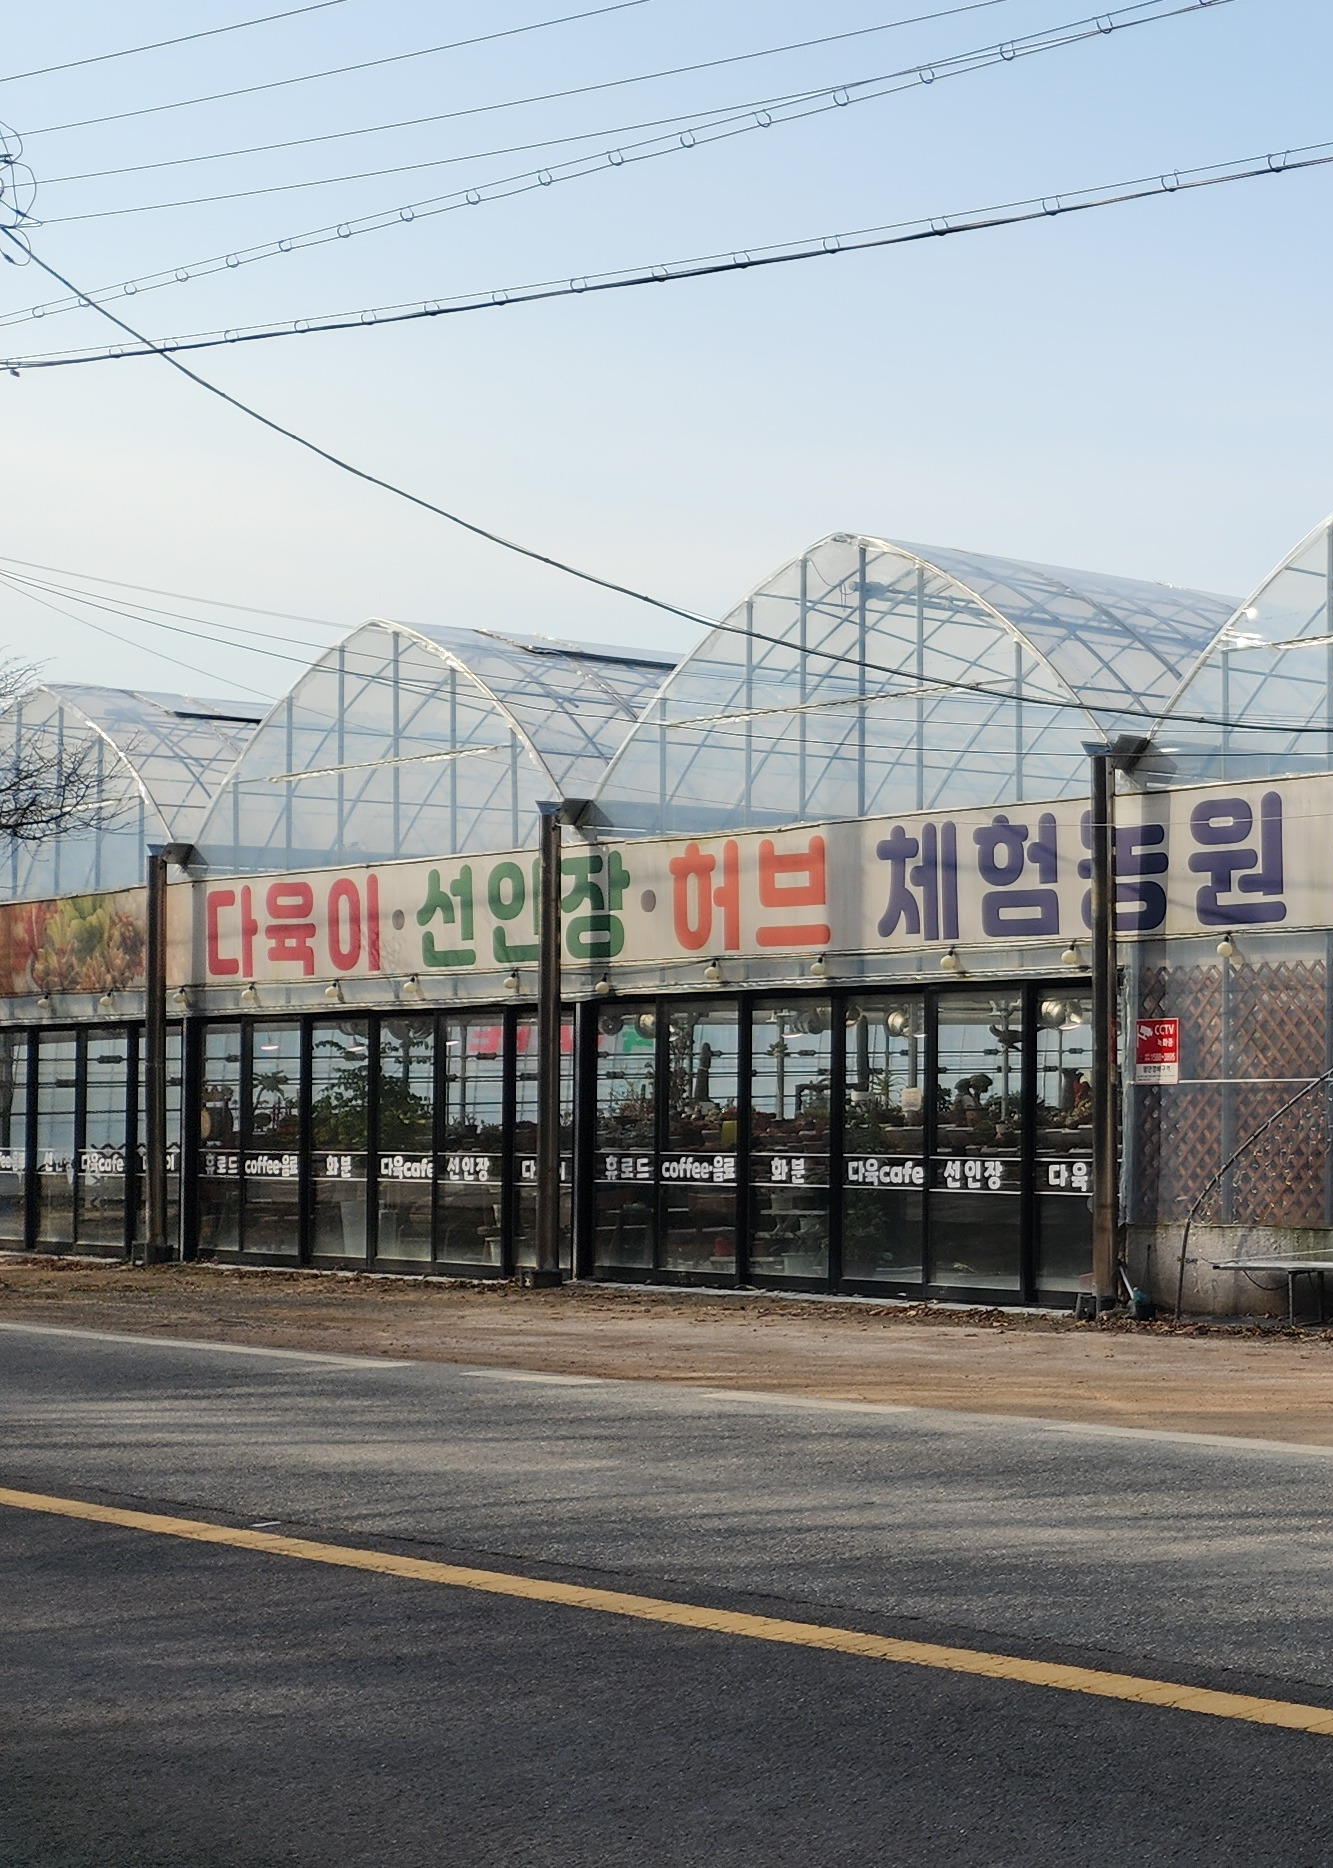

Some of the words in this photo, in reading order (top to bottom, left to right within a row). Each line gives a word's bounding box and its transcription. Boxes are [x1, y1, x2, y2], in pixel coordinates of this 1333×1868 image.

[876, 790, 1287, 942] 체험농원
[1154, 1024, 1175, 1036] CCTV
[205, 1153, 238, 1175] 휴로드
[325, 1154, 351, 1178] 화분
[446, 1156, 490, 1182] 선인장
[605, 1155, 651, 1180] 휴로드
[770, 1156, 806, 1184] 화분
[847, 1158, 924, 1186] 다육cafe
[943, 1160, 1003, 1190] 선인장
